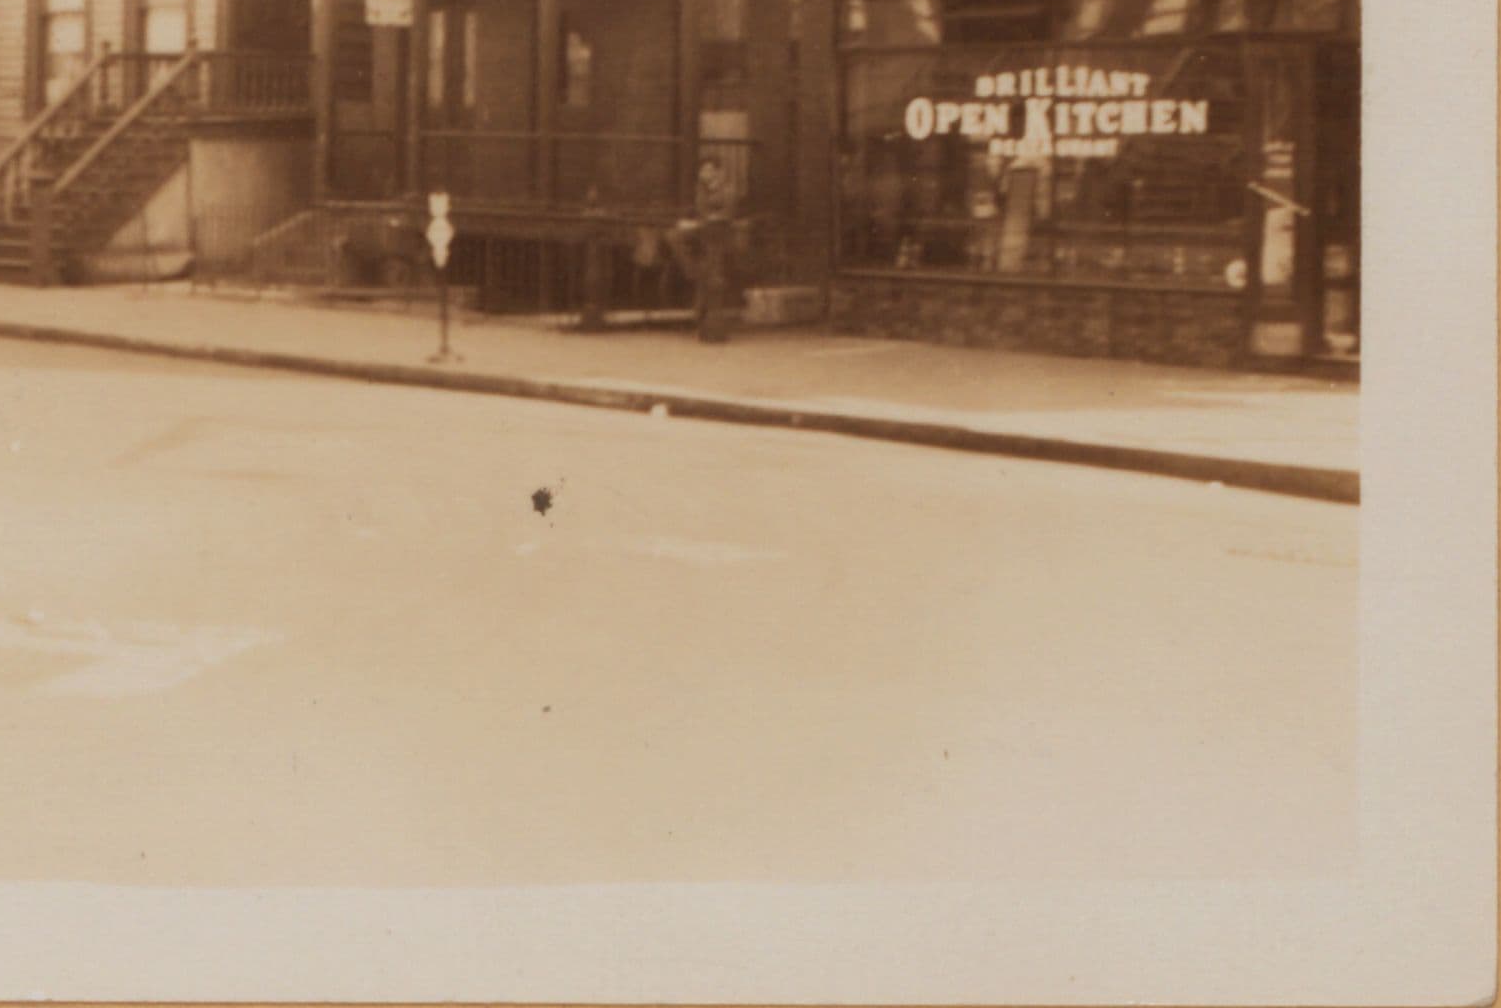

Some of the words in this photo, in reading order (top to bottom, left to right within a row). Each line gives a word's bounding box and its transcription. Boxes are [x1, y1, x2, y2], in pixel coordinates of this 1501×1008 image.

[976, 66, 1149, 97] BRILLIANT
[906, 98, 1009, 139] OPEN
[1025, 98, 1208, 138] KITCHEN
